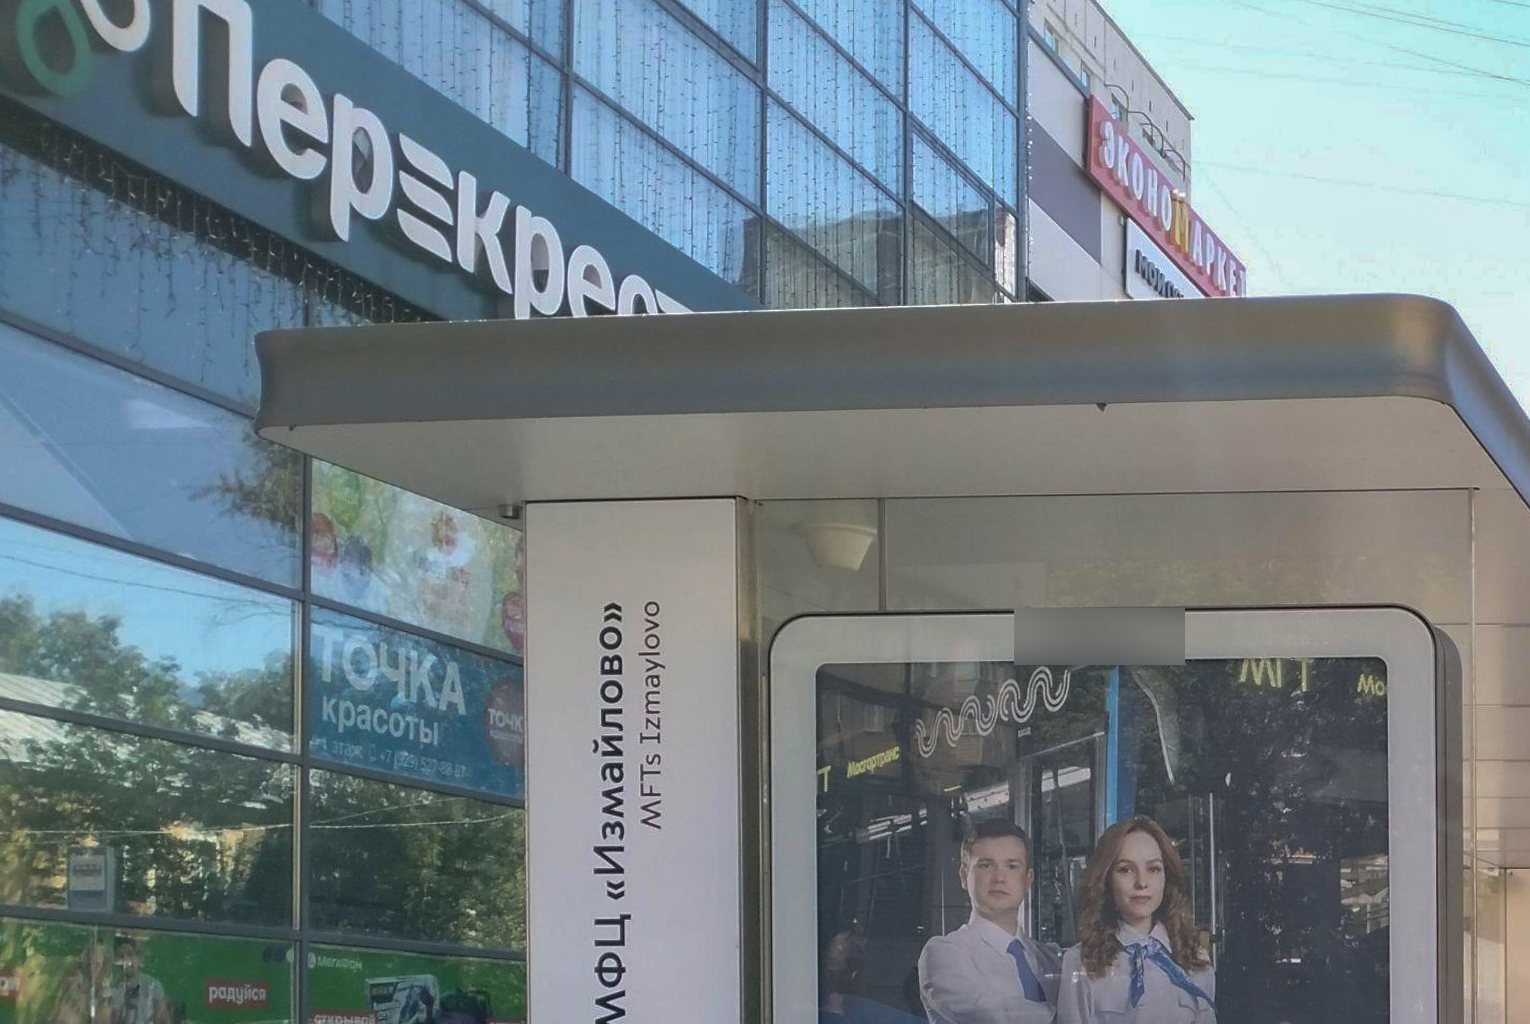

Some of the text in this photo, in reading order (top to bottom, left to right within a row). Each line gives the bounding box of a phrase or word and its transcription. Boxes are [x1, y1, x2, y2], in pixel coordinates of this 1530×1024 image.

[310, 623, 467, 716] ТОЧКА
[637, 600, 666, 830] MFTs Izmaylovo
[322, 695, 439, 746] красоты
[592, 602, 626, 902] «Измайлово»
[208, 984, 267, 1004] радуйся
